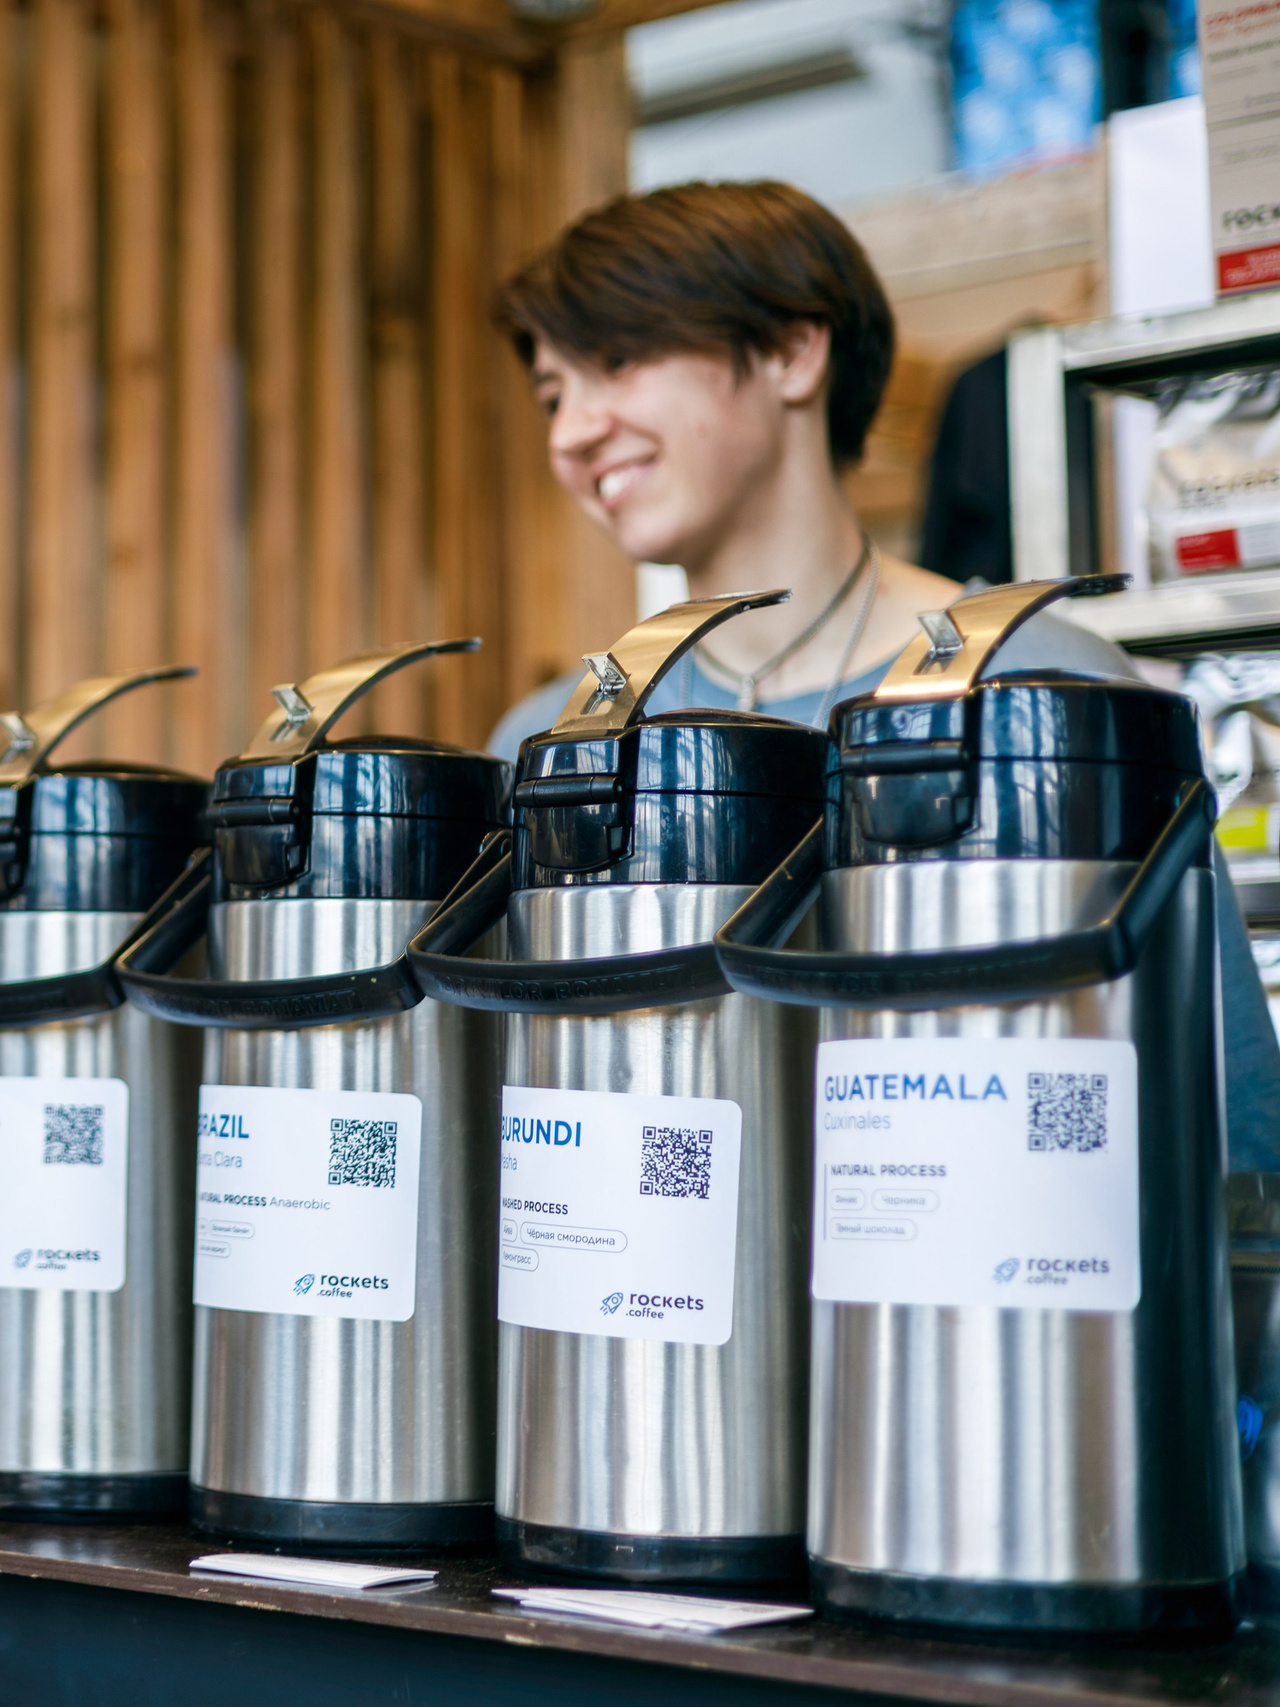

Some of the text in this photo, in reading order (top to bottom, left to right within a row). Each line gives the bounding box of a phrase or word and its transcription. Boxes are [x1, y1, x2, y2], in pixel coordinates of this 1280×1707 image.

[824, 1073, 1009, 1102] GUATEMALA
[824, 1111, 892, 1131] Cuxinales
[830, 1164, 947, 1178] NATURAL PROCESS
[223, 1194, 267, 1207] PROCESS
[270, 1196, 331, 1211] Anaerobic
[523, 1200, 569, 1216] PROCESS
[881, 1195, 927, 1207] Черника
[526, 1227, 616, 1247] Чёрная смородина
[863, 1224, 907, 1236] шоколад
[36, 1249, 101, 1262] rockets
[1027, 1256, 1111, 1274] rockets
[320, 1273, 389, 1290] rockets
[629, 1291, 705, 1311] rockets
